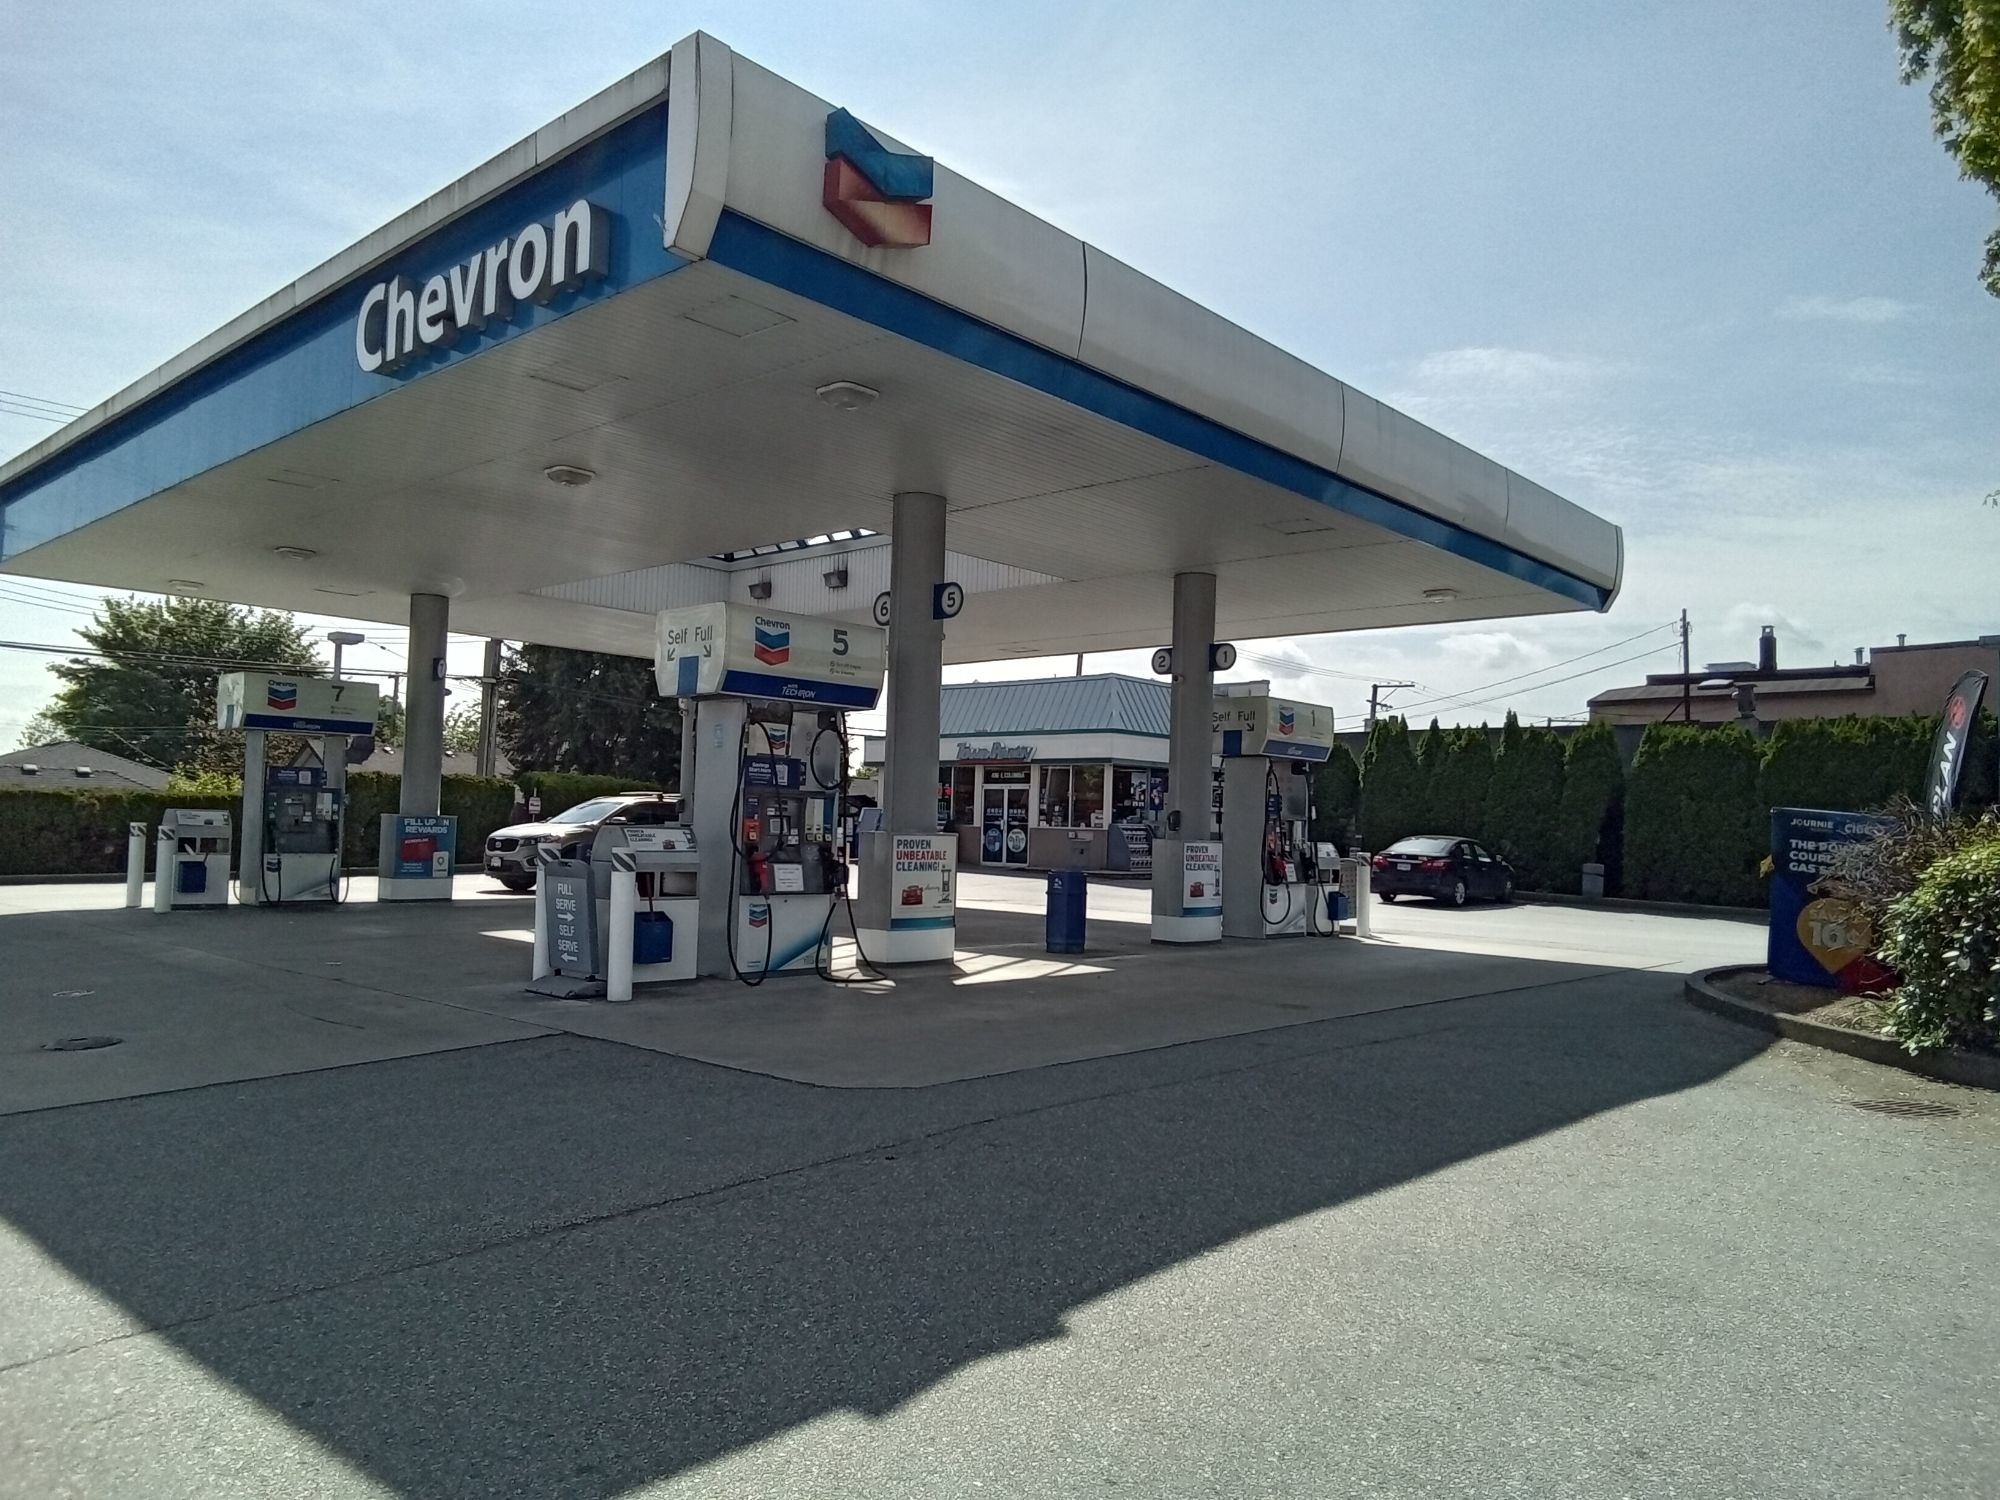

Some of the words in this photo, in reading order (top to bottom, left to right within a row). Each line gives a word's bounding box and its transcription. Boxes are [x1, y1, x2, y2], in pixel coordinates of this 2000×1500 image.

[356, 199, 591, 372] Chevron
[946, 591, 956, 608] 5
[880, 601, 888, 616] 6
[754, 615, 791, 631] Chevron
[667, 629, 688, 646] Self
[694, 625, 713, 642] Full
[832, 628, 849, 656] 5
[1158, 656, 1167, 669] 2
[1222, 651, 1228, 663] 1
[331, 685, 345, 702] 7
[1212, 711, 1231, 723] Self
[1237, 710, 1256, 722] Full
[1311, 709, 1316, 727] 1
[404, 818, 424, 826] FILL
[424, 818, 437, 826] UP
[1790, 818, 1834, 829] JOURNIE
[405, 826, 448, 834] REWARDS
[896, 839, 932, 850] PROVEN
[1789, 839, 1817, 850] THE
[896, 850, 948, 861] UNBEATABLE
[896, 861, 940, 872] CLEANING!
[1789, 862, 1817, 873] GAS
[557, 882, 574, 896] FULL
[555, 898, 577, 912] SERVE
[558, 924, 576, 936] SELF
[557, 939, 579, 953] SERVE
